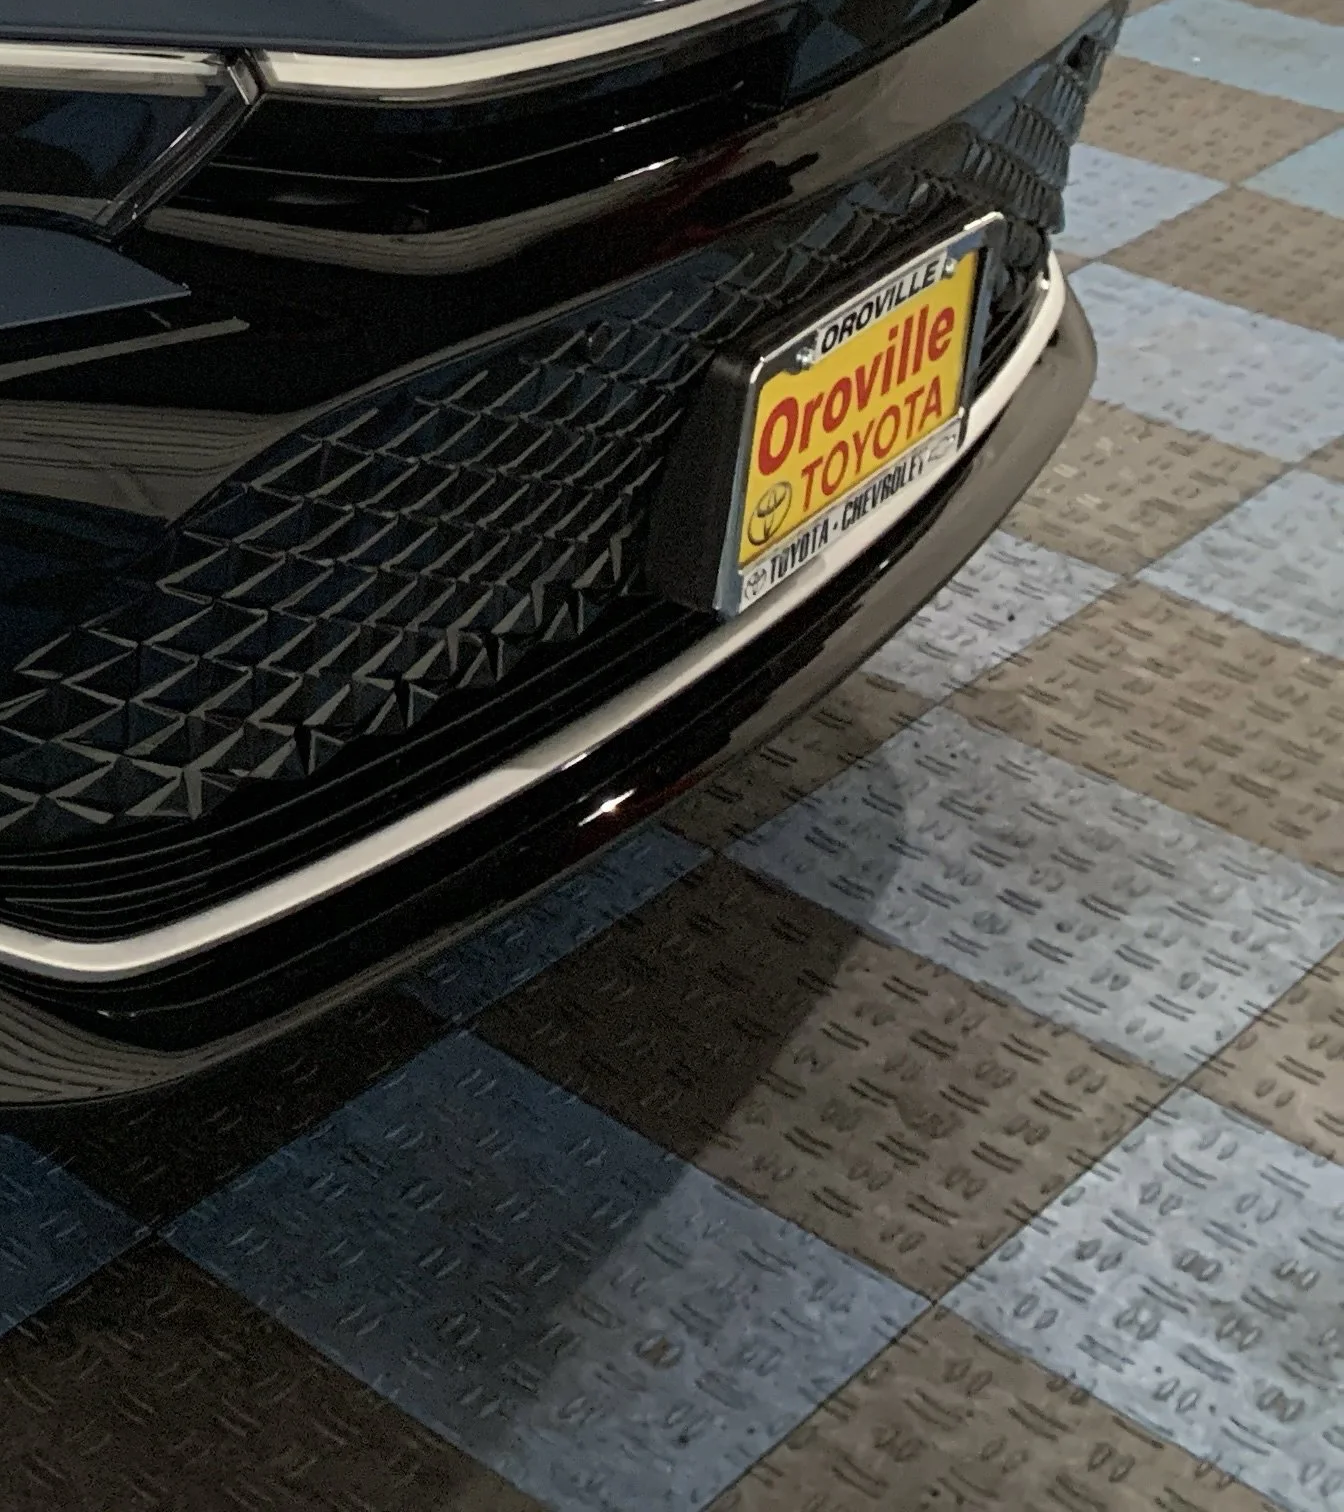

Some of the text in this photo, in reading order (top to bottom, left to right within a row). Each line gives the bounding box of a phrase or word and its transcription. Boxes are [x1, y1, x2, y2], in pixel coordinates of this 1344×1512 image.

[821, 259, 940, 354] OROVILLE
[758, 304, 955, 476] Oroville
[801, 375, 942, 512] TOYOTA
[769, 452, 925, 584] TOYOTA CHEVROLET
